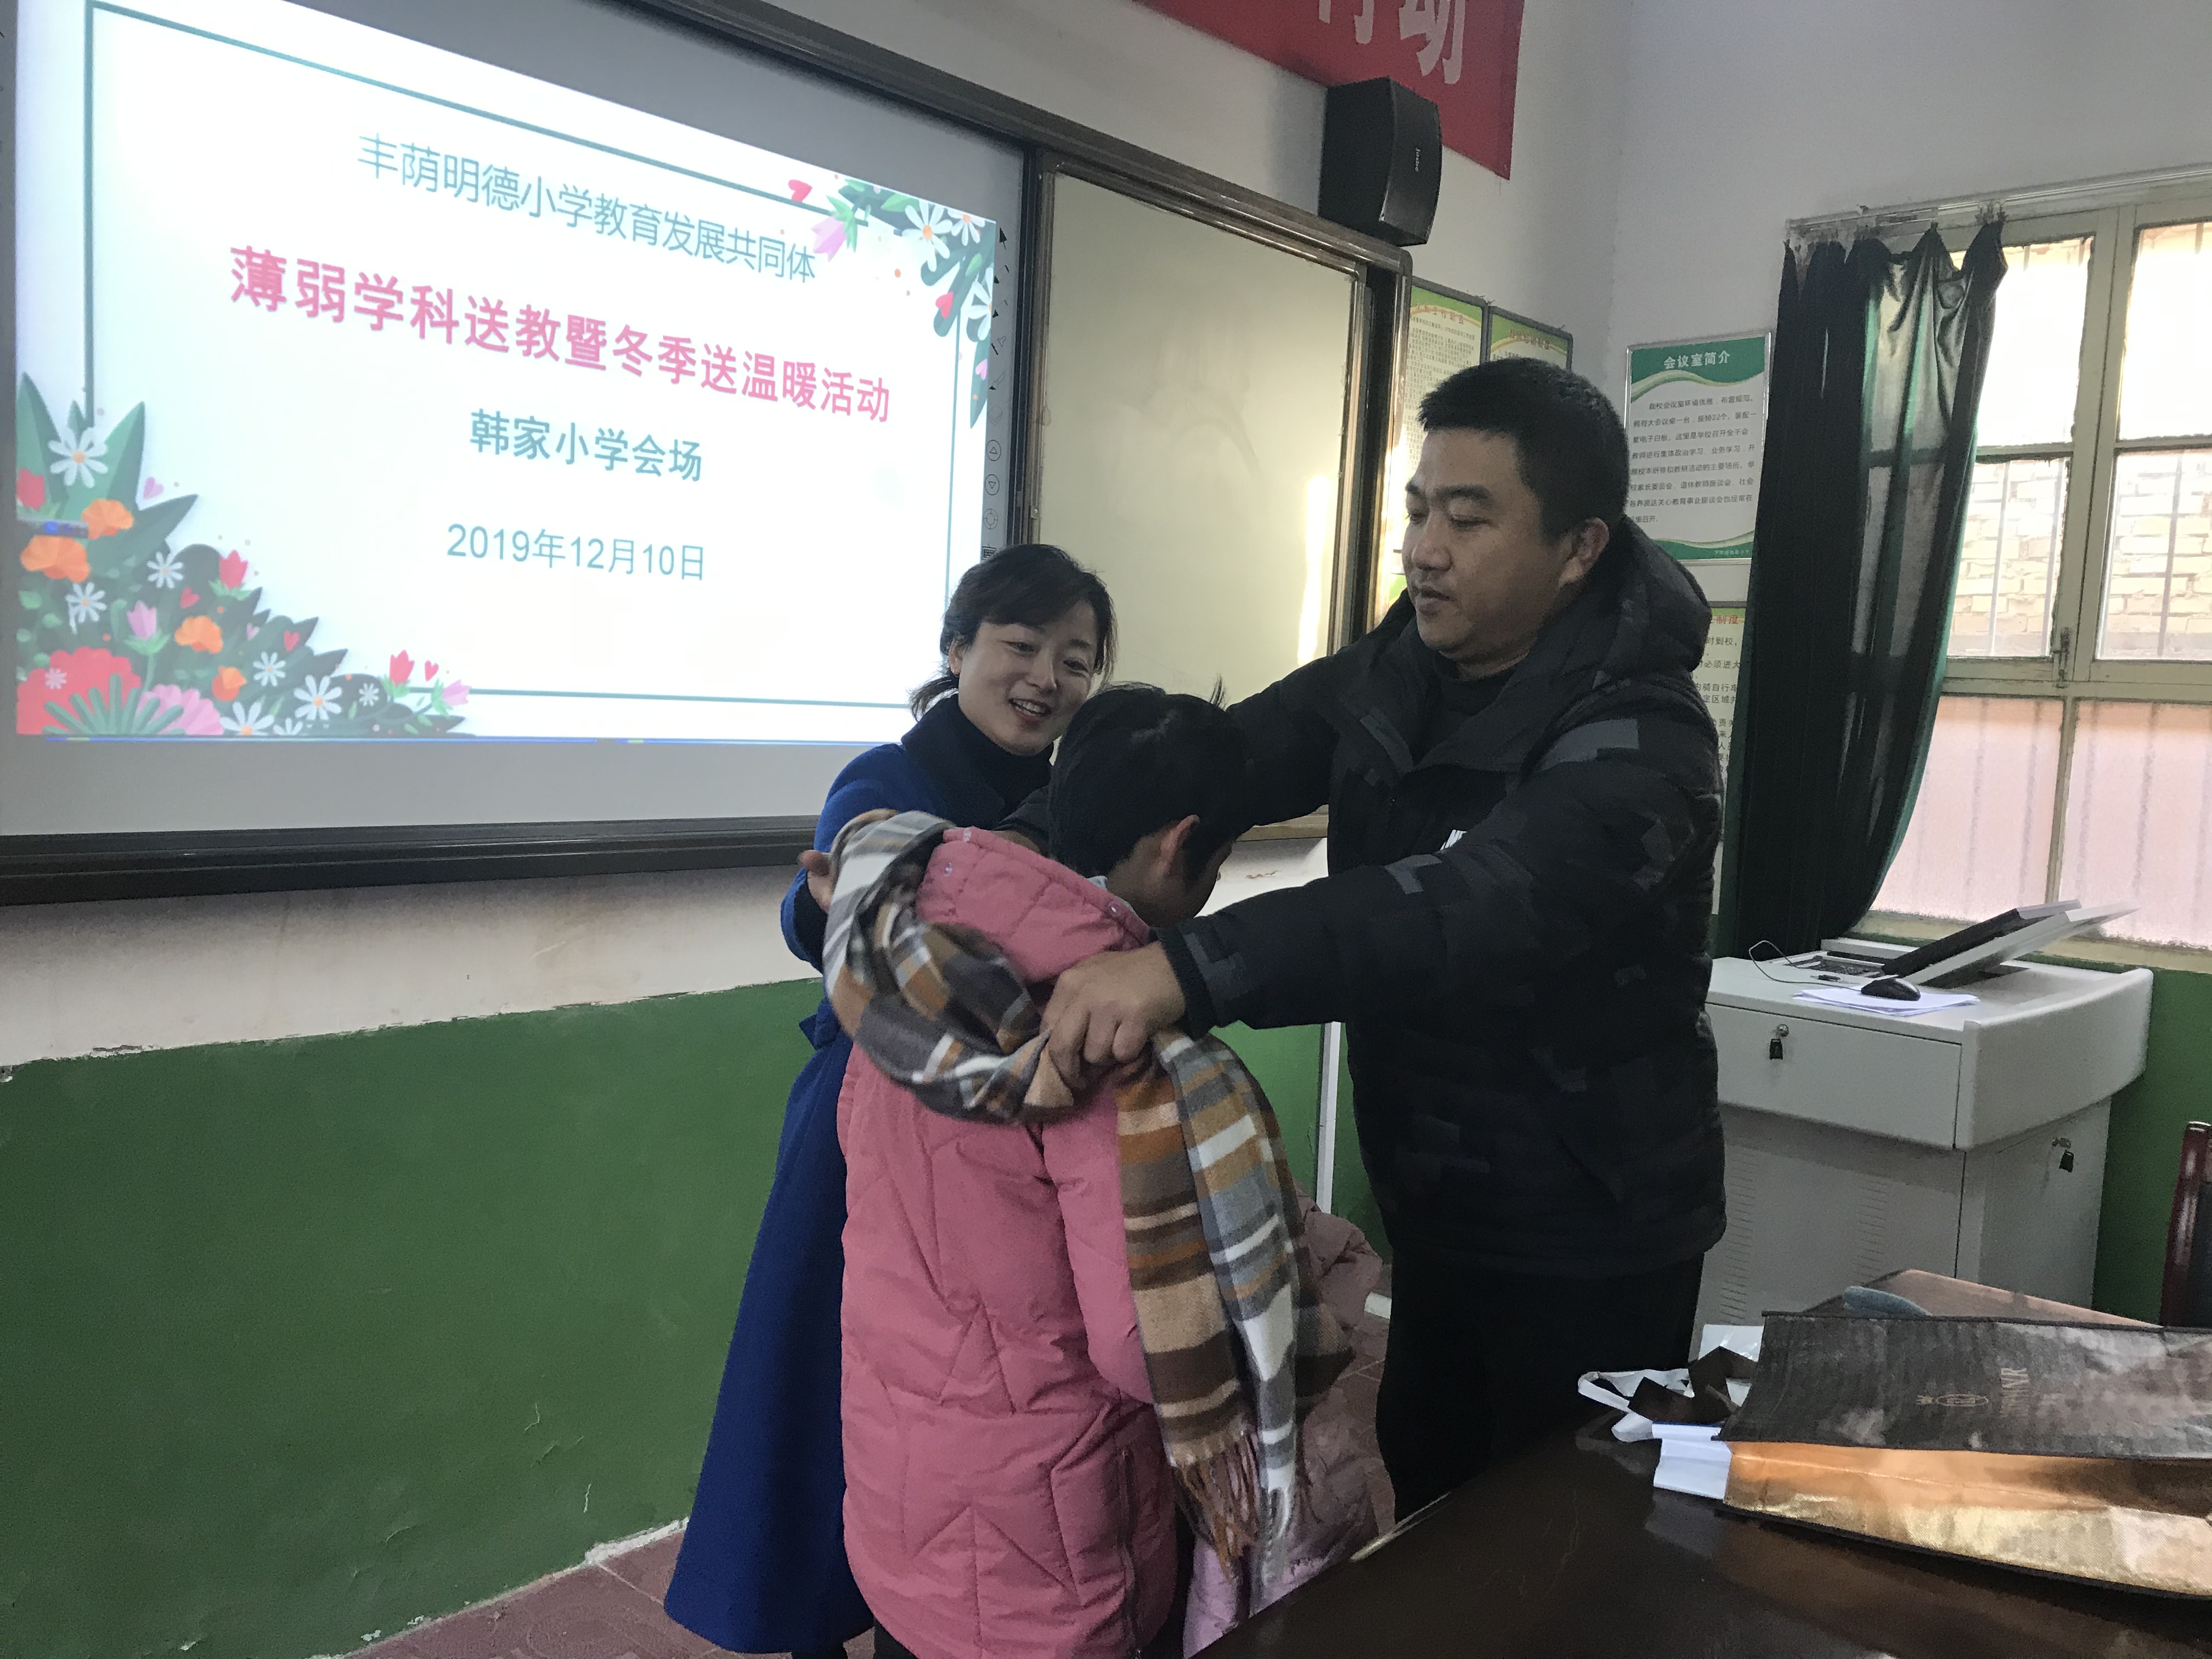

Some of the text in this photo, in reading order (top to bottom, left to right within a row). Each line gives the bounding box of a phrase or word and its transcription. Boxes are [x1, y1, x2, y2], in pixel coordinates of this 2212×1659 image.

[357, 132, 815, 283] 丰荫明德小学教育发展共同体
[229, 245, 890, 422] 薄弱学科送教暨冬季送温暖活动
[1663, 350, 1730, 369] 会议室简介
[470, 408, 702, 482] 韩家小学会场
[447, 523, 704, 580] 2019年12月10日
[1710, 614, 1738, 624] 制度
